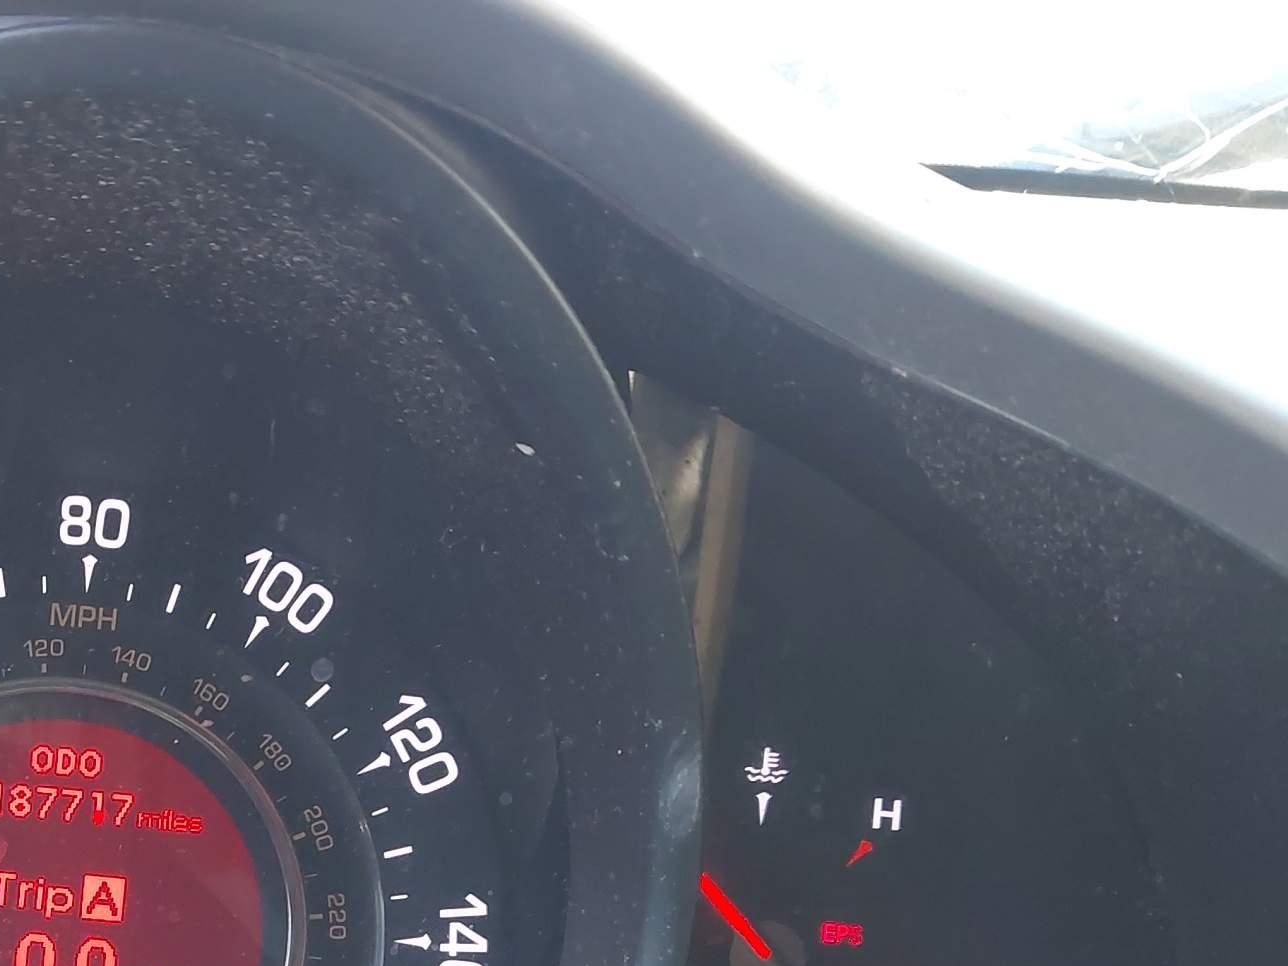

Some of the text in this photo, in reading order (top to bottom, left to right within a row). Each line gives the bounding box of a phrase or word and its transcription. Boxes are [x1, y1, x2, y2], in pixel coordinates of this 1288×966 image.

[59, 495, 131, 549] 80
[242, 548, 334, 634] 100
[49, 603, 118, 631] MPH
[23, 638, 65, 659] 120
[111, 645, 152, 673] 140
[192, 677, 230, 713] 160
[30, 745, 104, 778] ODO
[259, 733, 292, 773] 180
[381, 695, 459, 795] 120
[136, 811, 204, 834] miles
[303, 805, 334, 852] 200
[871, 798, 903, 831] H
[85, 880, 119, 917] A
[326, 892, 347, 941] 220
[821, 921, 863, 946] EPS
